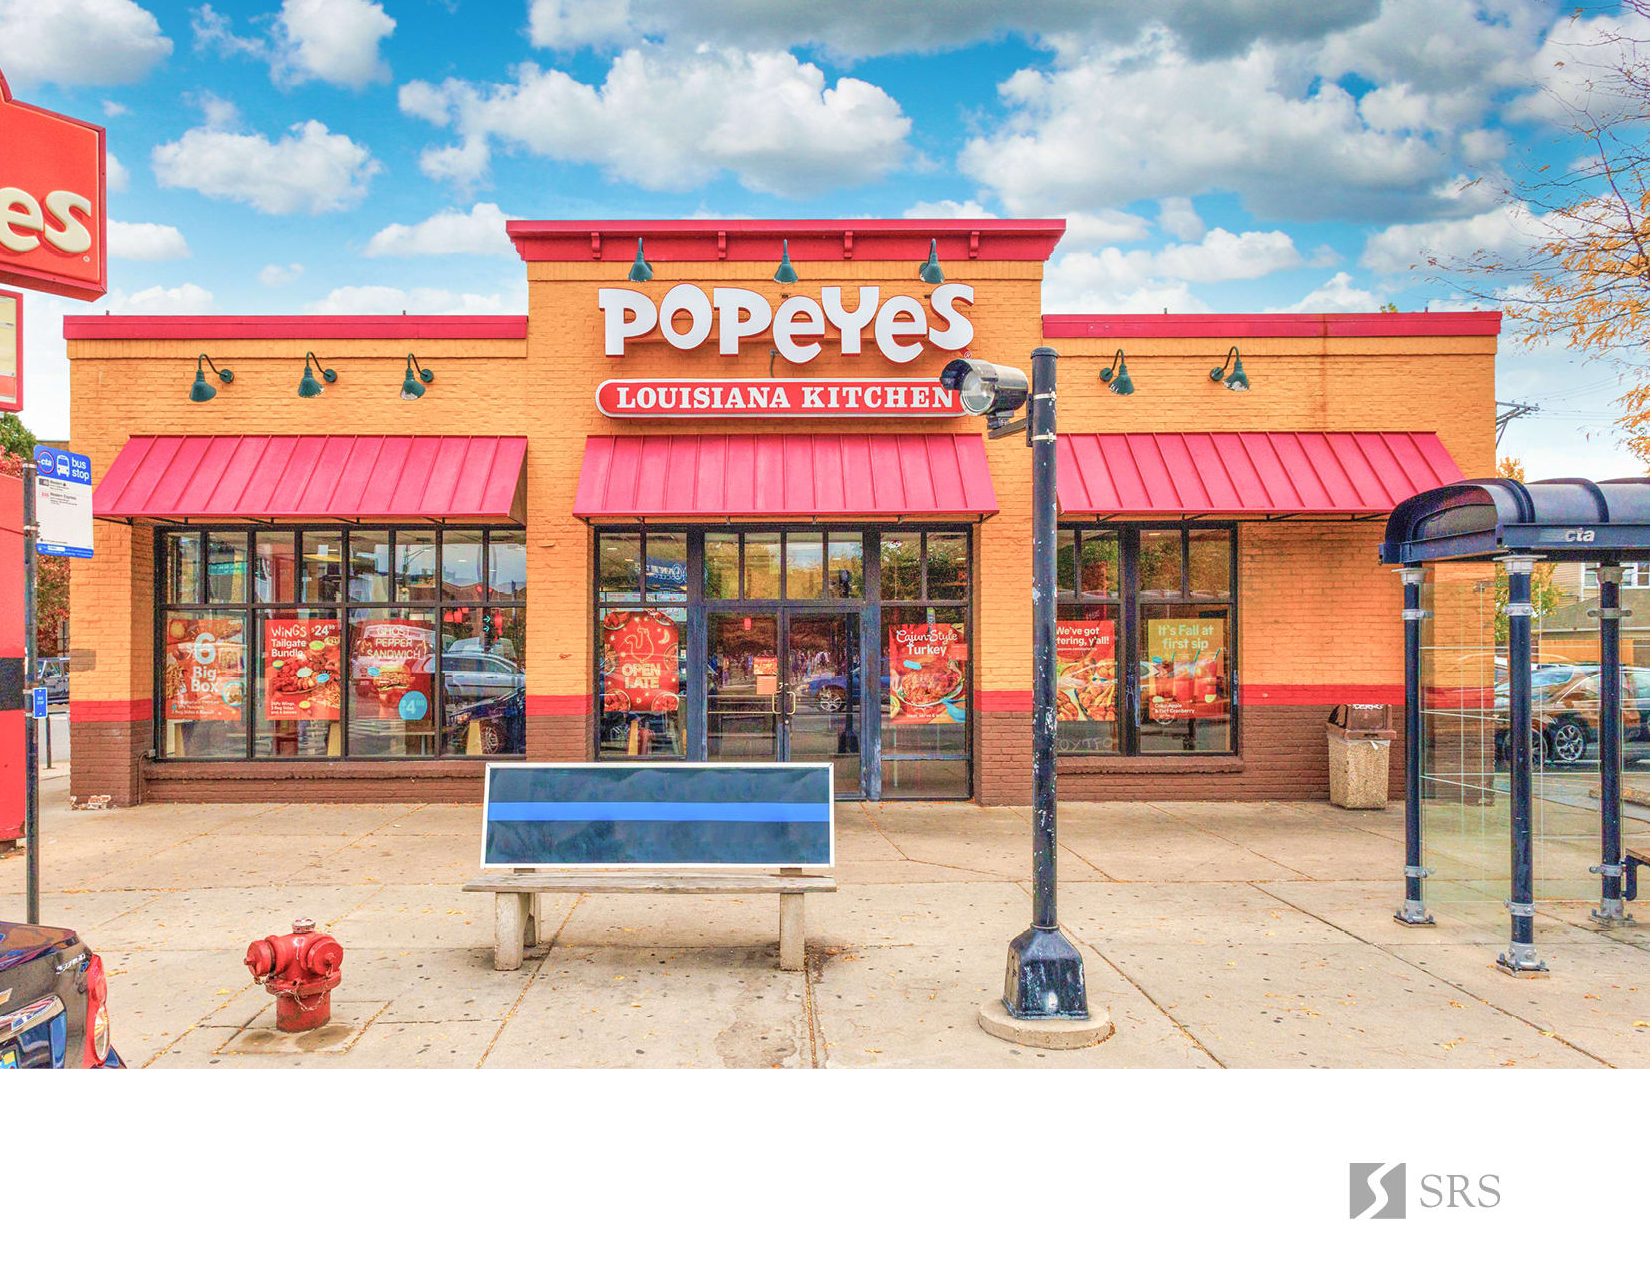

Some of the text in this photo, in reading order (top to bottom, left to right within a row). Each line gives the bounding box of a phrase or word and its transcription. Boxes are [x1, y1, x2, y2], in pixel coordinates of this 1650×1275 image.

[616, 387, 953, 409] LOUISIANA KITCHEN
[41, 458, 52, 466] cta
[72, 457, 86, 469] bus
[72, 469, 90, 482] stop
[1565, 527, 1595, 542] cta
[1084, 627, 1100, 637] got
[1158, 625, 1215, 636] It's Fall at
[271, 639, 307, 649] Tailgate
[375, 638, 413, 648] PEPPER
[896, 630, 958, 645] Cajun-Style
[1089, 637, 1109, 646] y'all!
[907, 644, 947, 657] Turkey
[1163, 638, 1208, 651] first sip
[271, 649, 304, 658] Bundle
[367, 649, 421, 659] SANDWICH
[193, 666, 216, 681] Big
[621, 662, 661, 677] OPEN
[191, 679, 219, 692] Box
[625, 675, 660, 690] LATE
